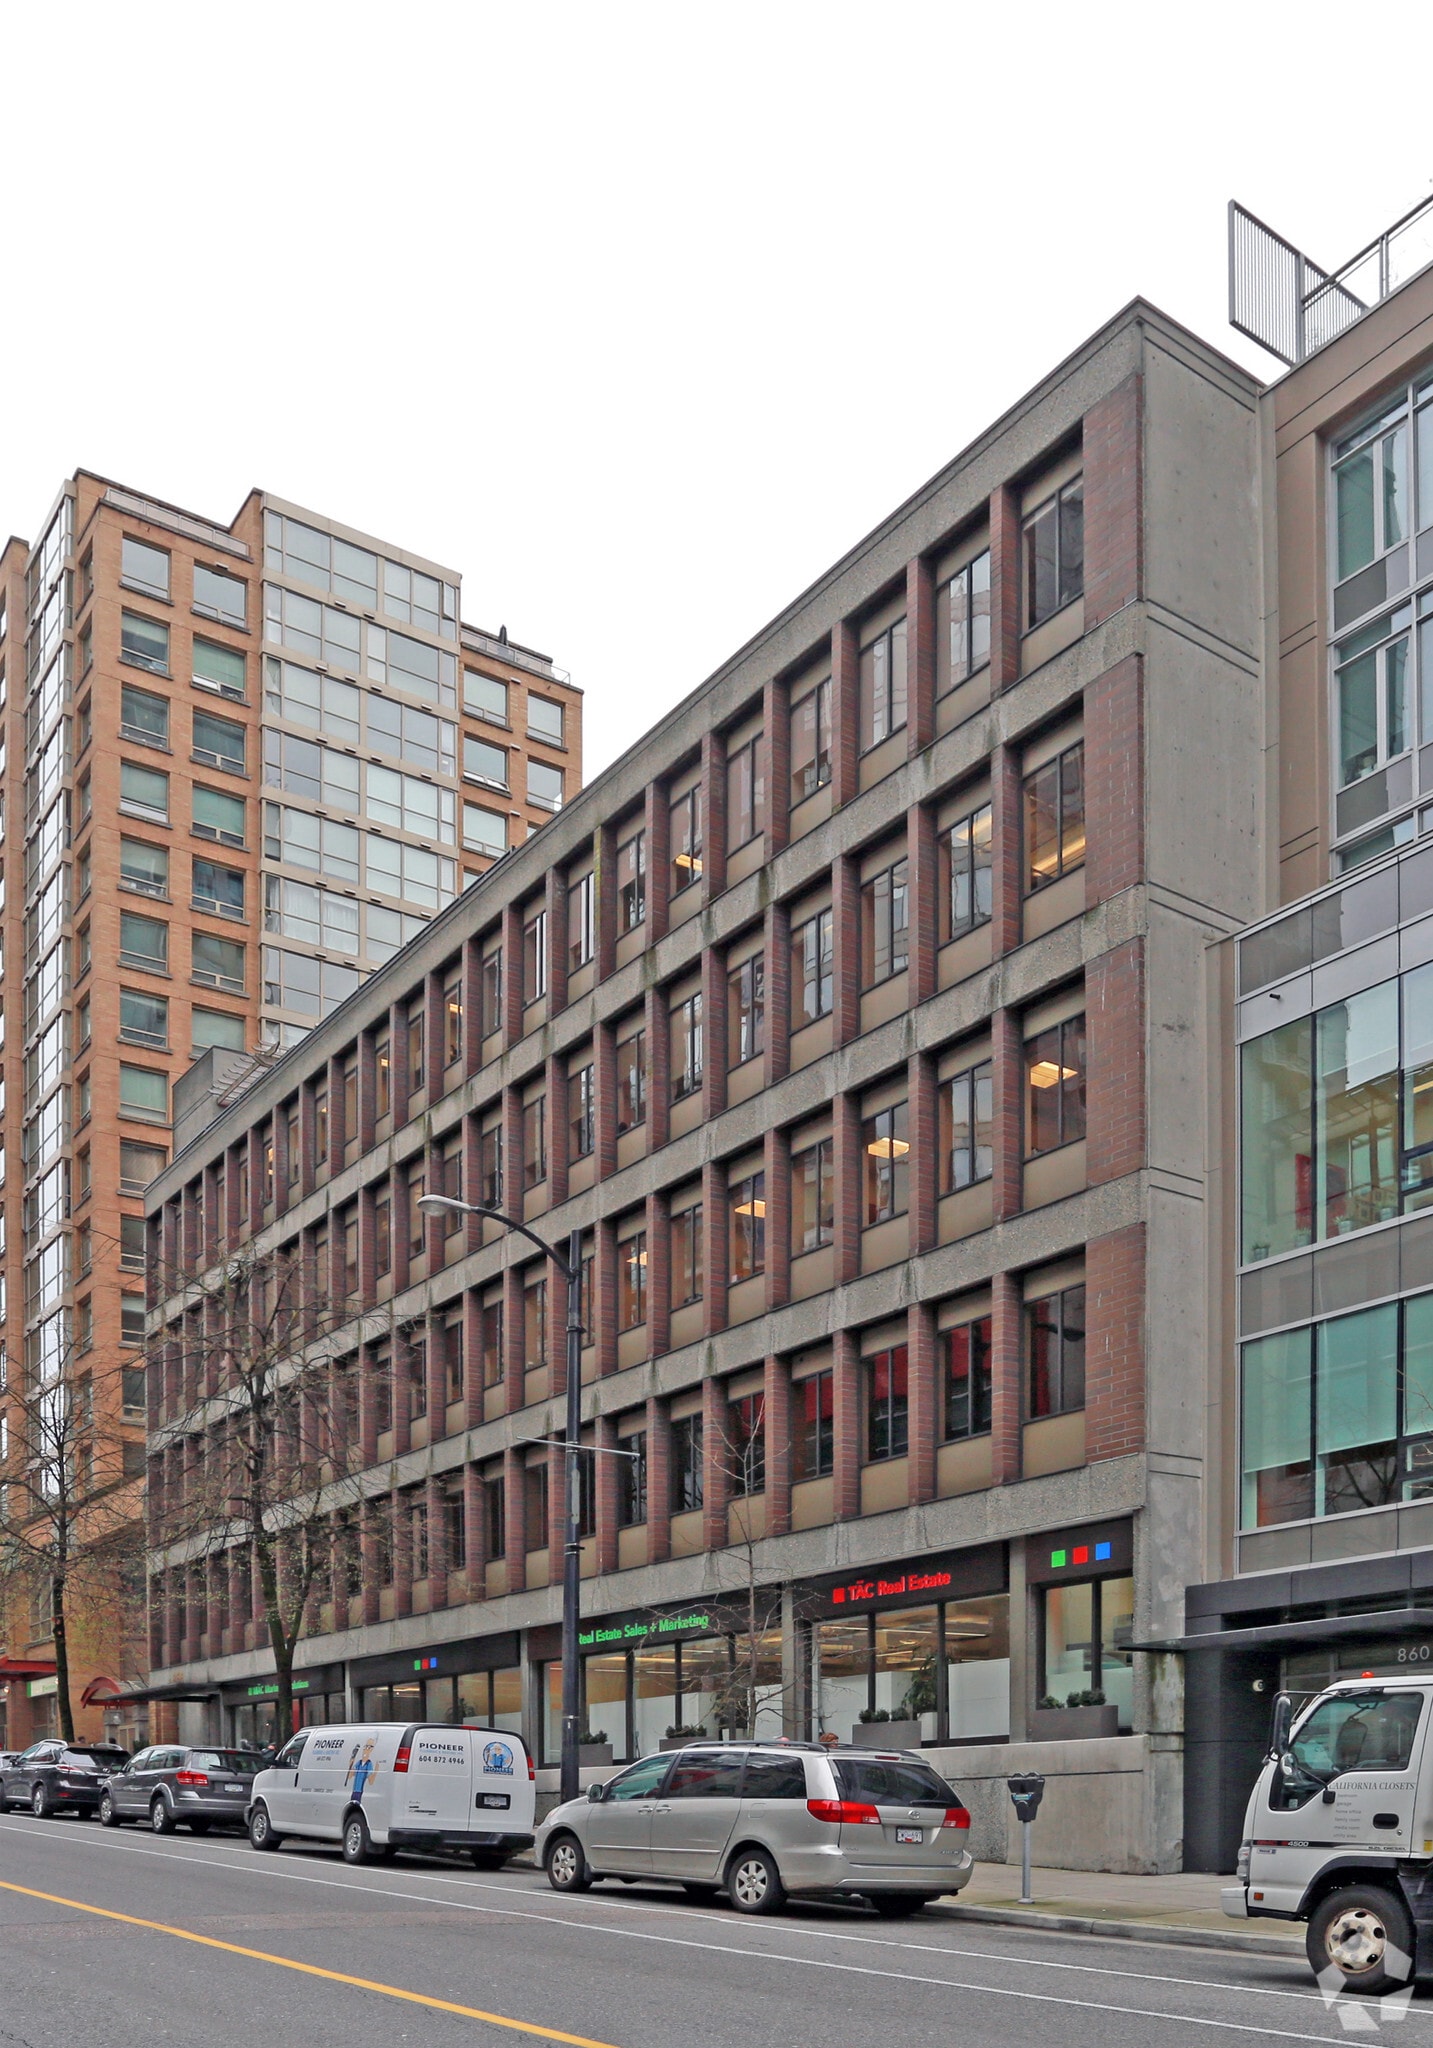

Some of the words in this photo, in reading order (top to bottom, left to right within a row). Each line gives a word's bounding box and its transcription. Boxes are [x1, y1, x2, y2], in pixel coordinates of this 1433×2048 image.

[877, 1576, 905, 1596] Real
[908, 1572, 951, 1591] Estate
[595, 1627, 622, 1642] Estate
[624, 1623, 648, 1637] Sales
[659, 1614, 709, 1632] Marketing
[1398, 1645, 1430, 1662] 860
[314, 1739, 345, 1749] PIONEER
[419, 1742, 464, 1751] PIONEER
[433, 1756, 447, 1764] 872
[448, 1757, 465, 1765] 4946
[1329, 1781, 1377, 1790] CALIFORNIA
[1379, 1781, 1416, 1790] CLOSETS
